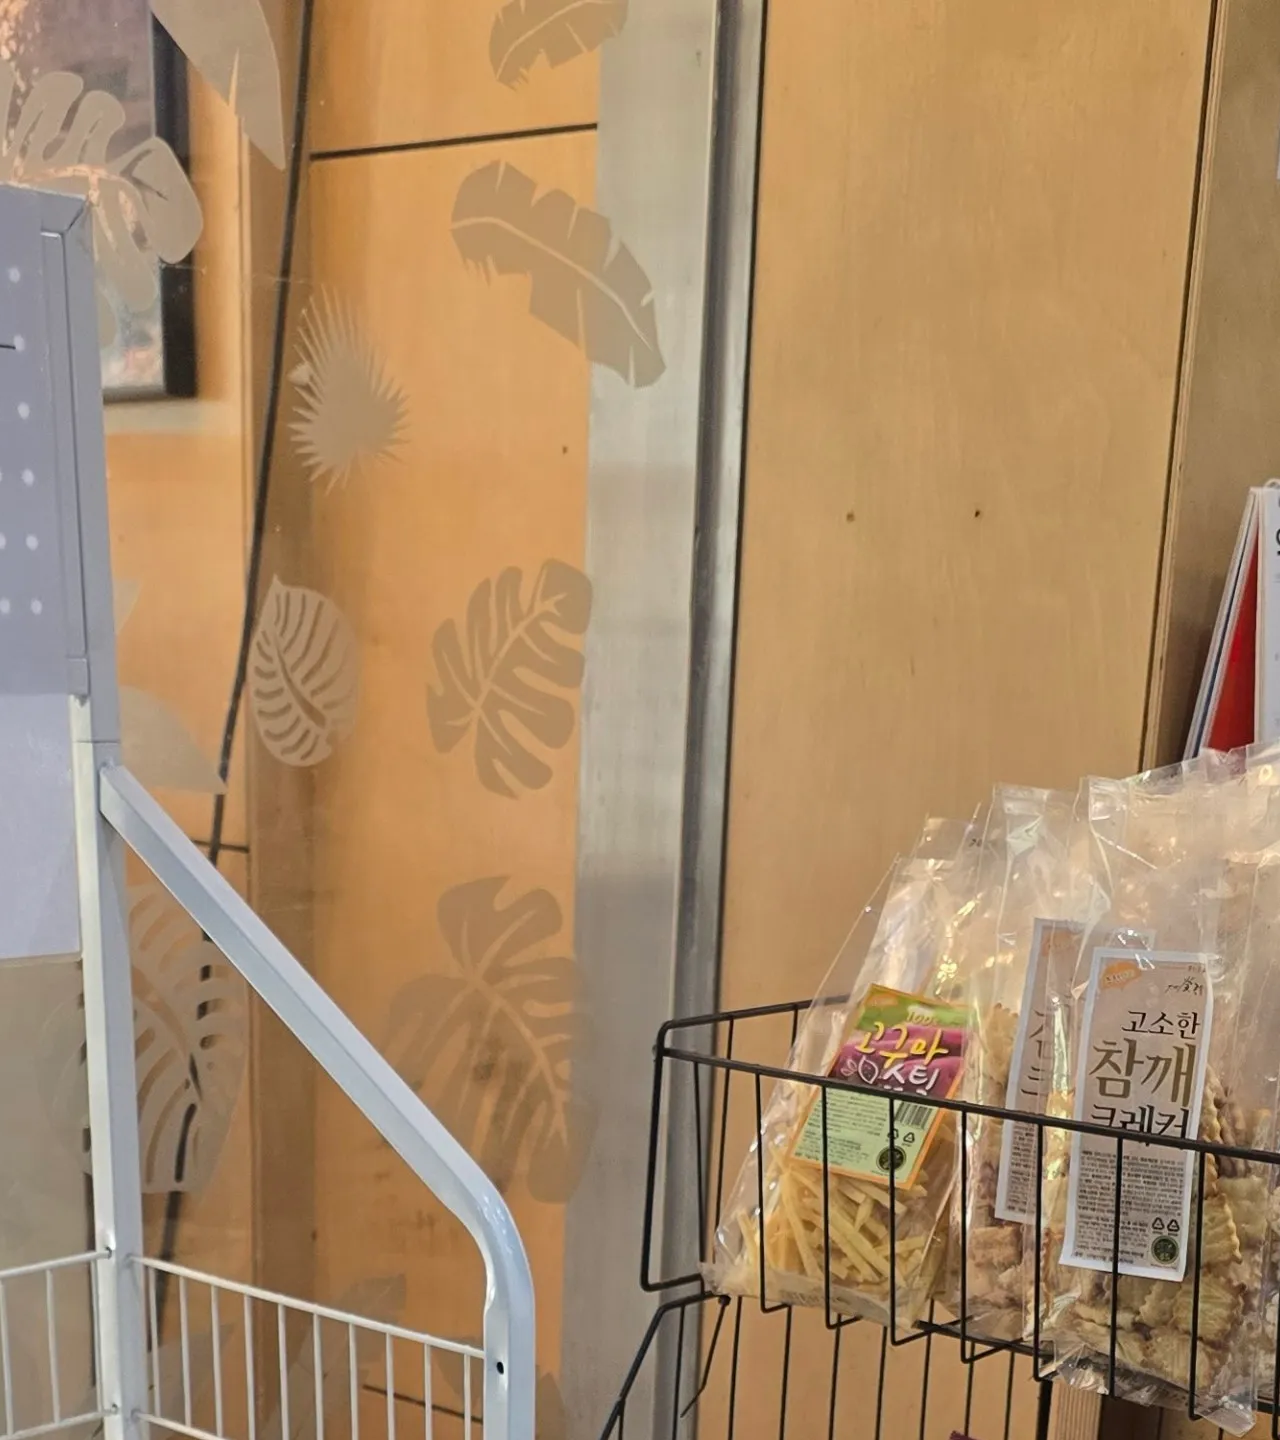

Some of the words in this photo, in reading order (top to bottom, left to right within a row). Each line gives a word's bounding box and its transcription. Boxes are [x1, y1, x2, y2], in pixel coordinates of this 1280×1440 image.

[855, 1023, 949, 1067] 고구마
[1121, 1010, 1201, 1040] 고소한
[1090, 1037, 1197, 1108] 참깨
